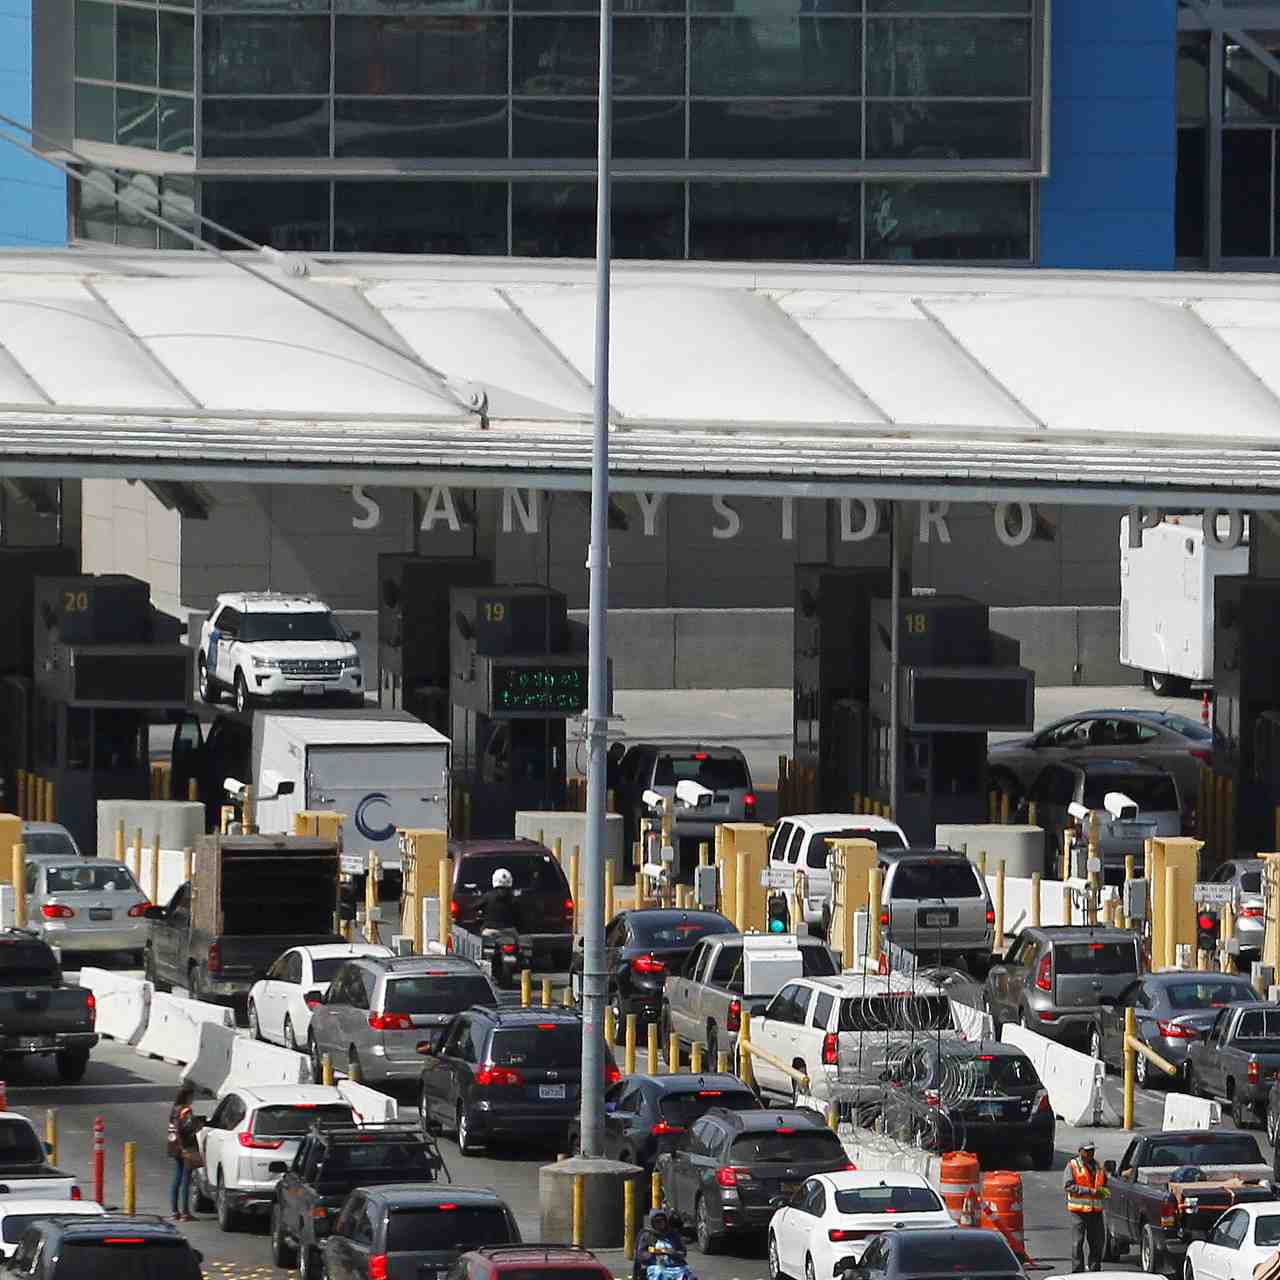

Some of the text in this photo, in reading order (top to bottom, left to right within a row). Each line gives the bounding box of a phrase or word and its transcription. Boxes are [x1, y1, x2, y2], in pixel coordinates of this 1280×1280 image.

[352, 485, 541, 533] SAN
[635, 490, 1036, 546] YSIDRO
[64, 591, 88, 613] 20
[484, 602, 506, 623] 19
[905, 613, 929, 633] 18
